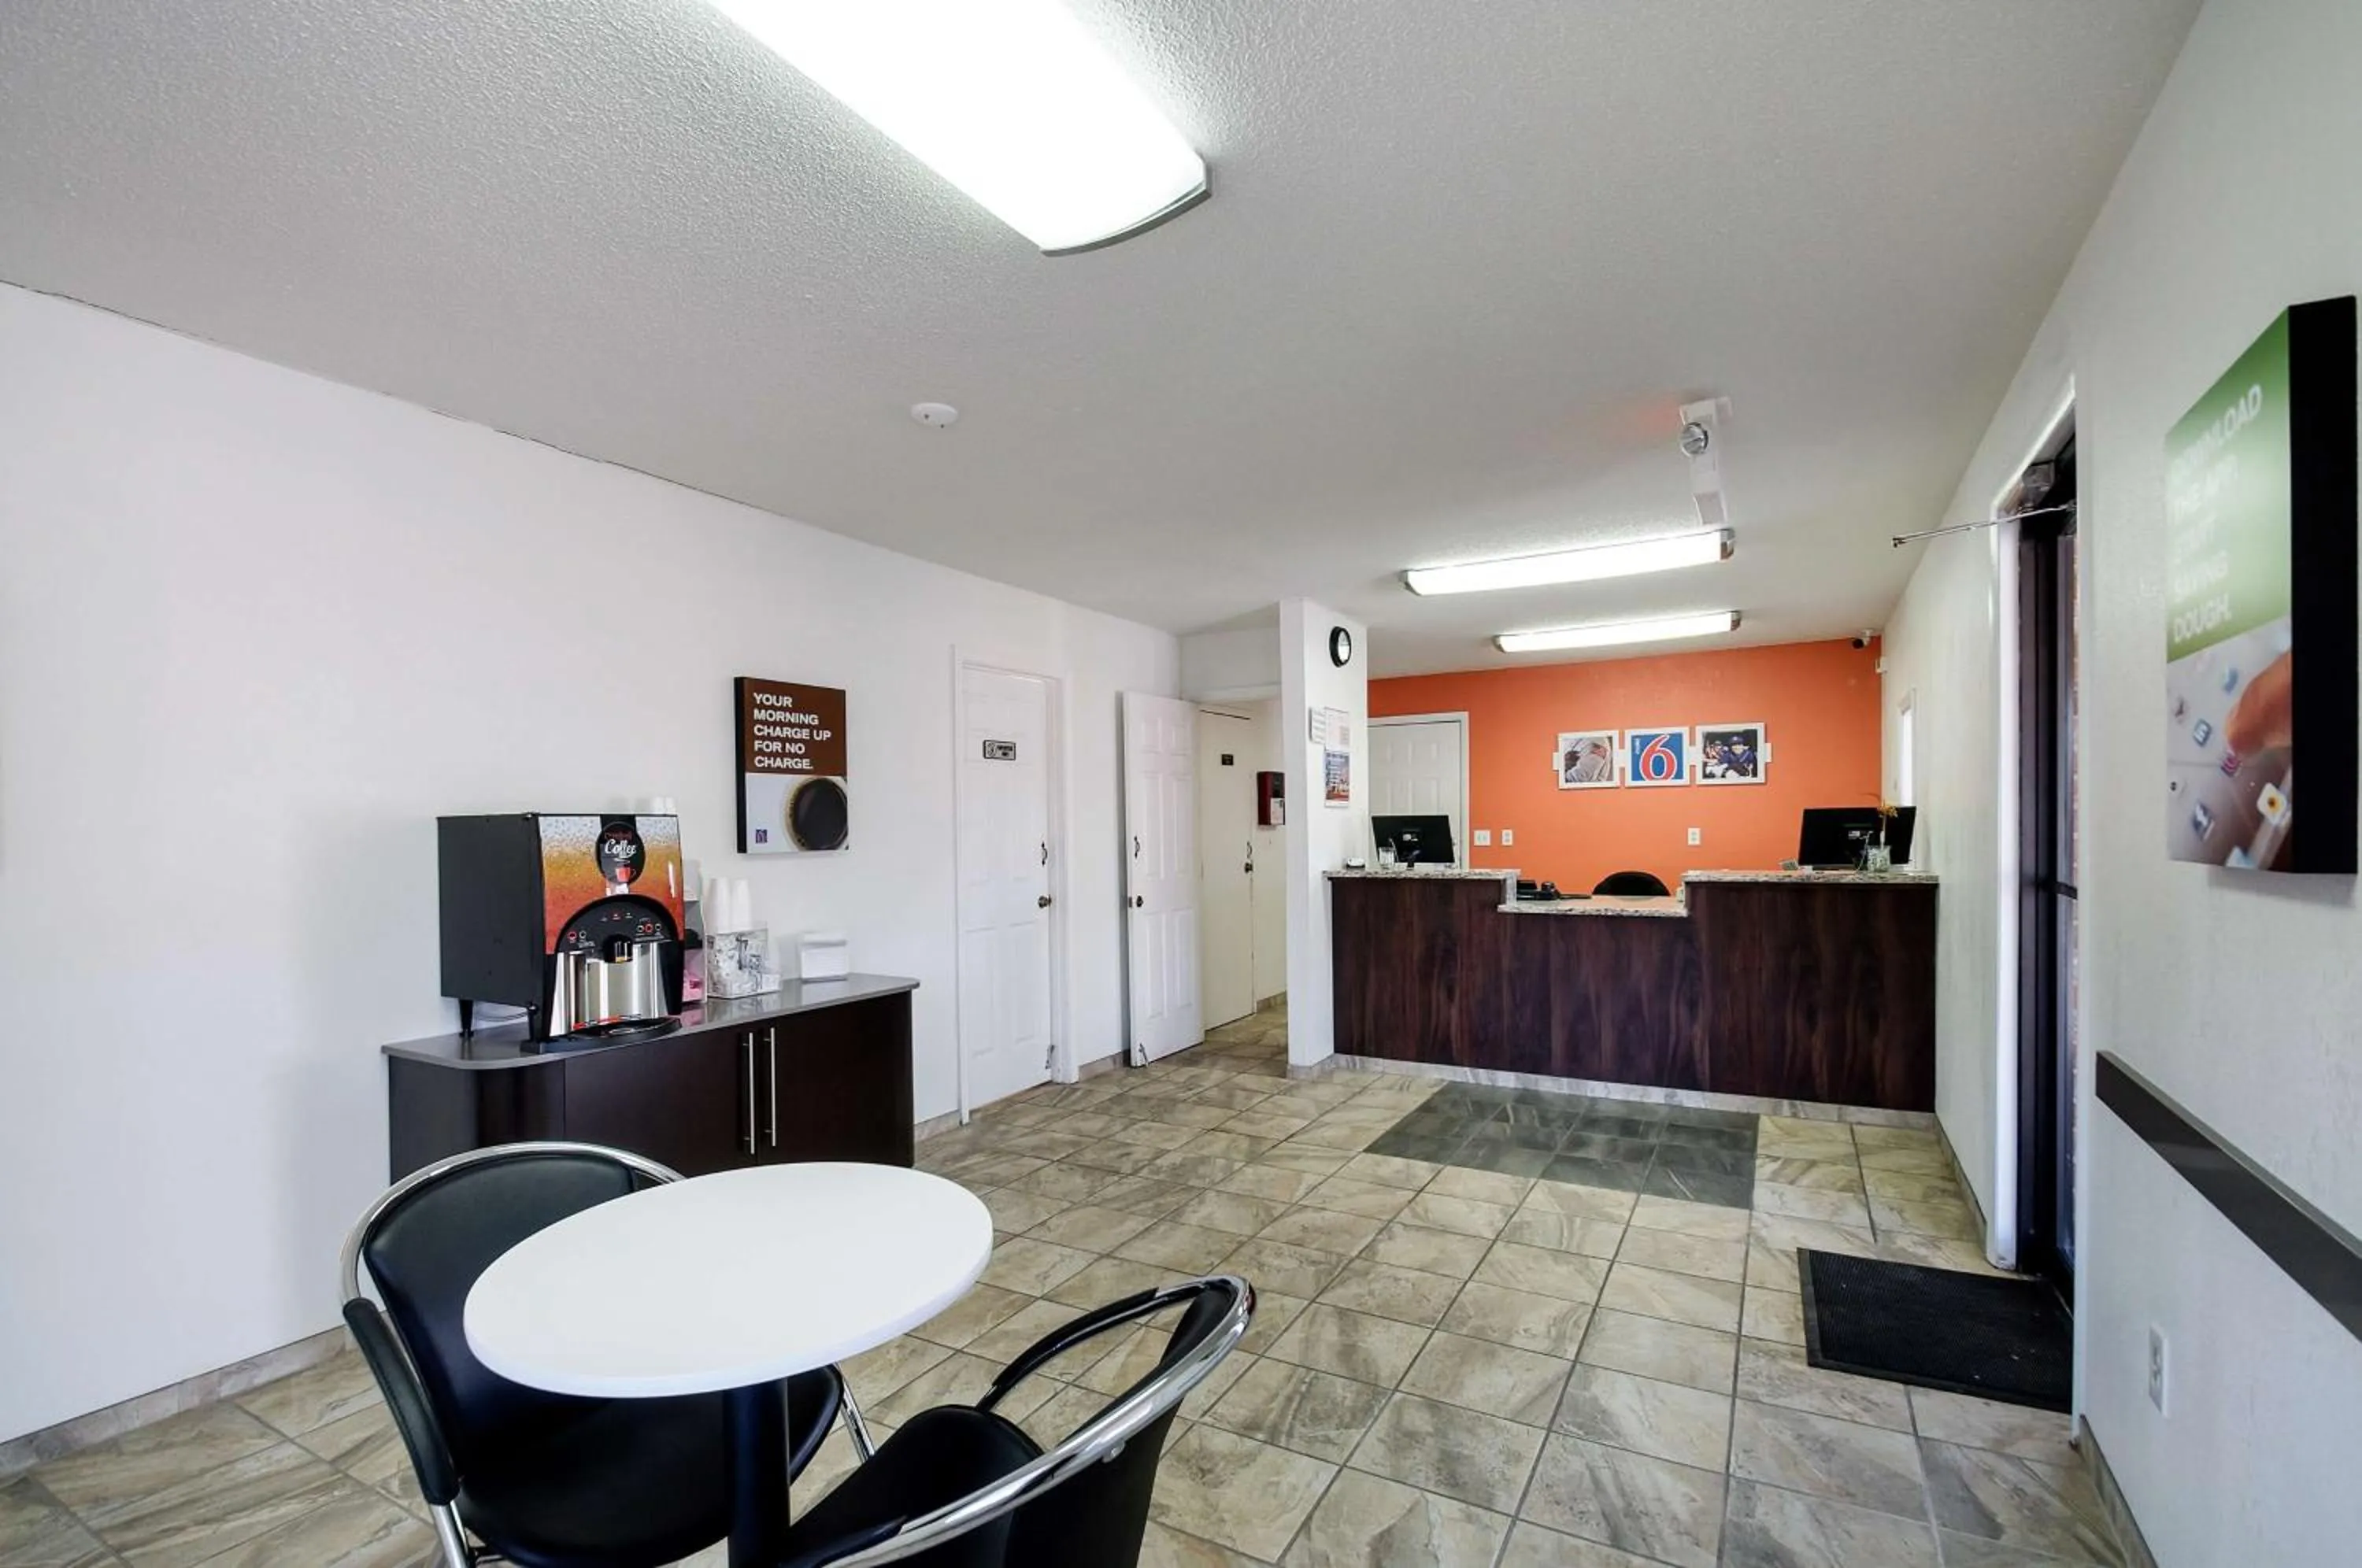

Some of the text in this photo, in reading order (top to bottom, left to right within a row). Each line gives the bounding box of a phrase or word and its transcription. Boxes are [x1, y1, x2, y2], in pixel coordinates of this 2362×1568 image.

[753, 692, 793, 708] YOUR
[753, 708, 820, 725] MORNING
[753, 724, 831, 741] CHARGE UP
[753, 740, 805, 755] FOR NO
[754, 756, 813, 770] CHARGE.
[1639, 734, 1678, 782] 6
[605, 838, 637, 860] Coffee
